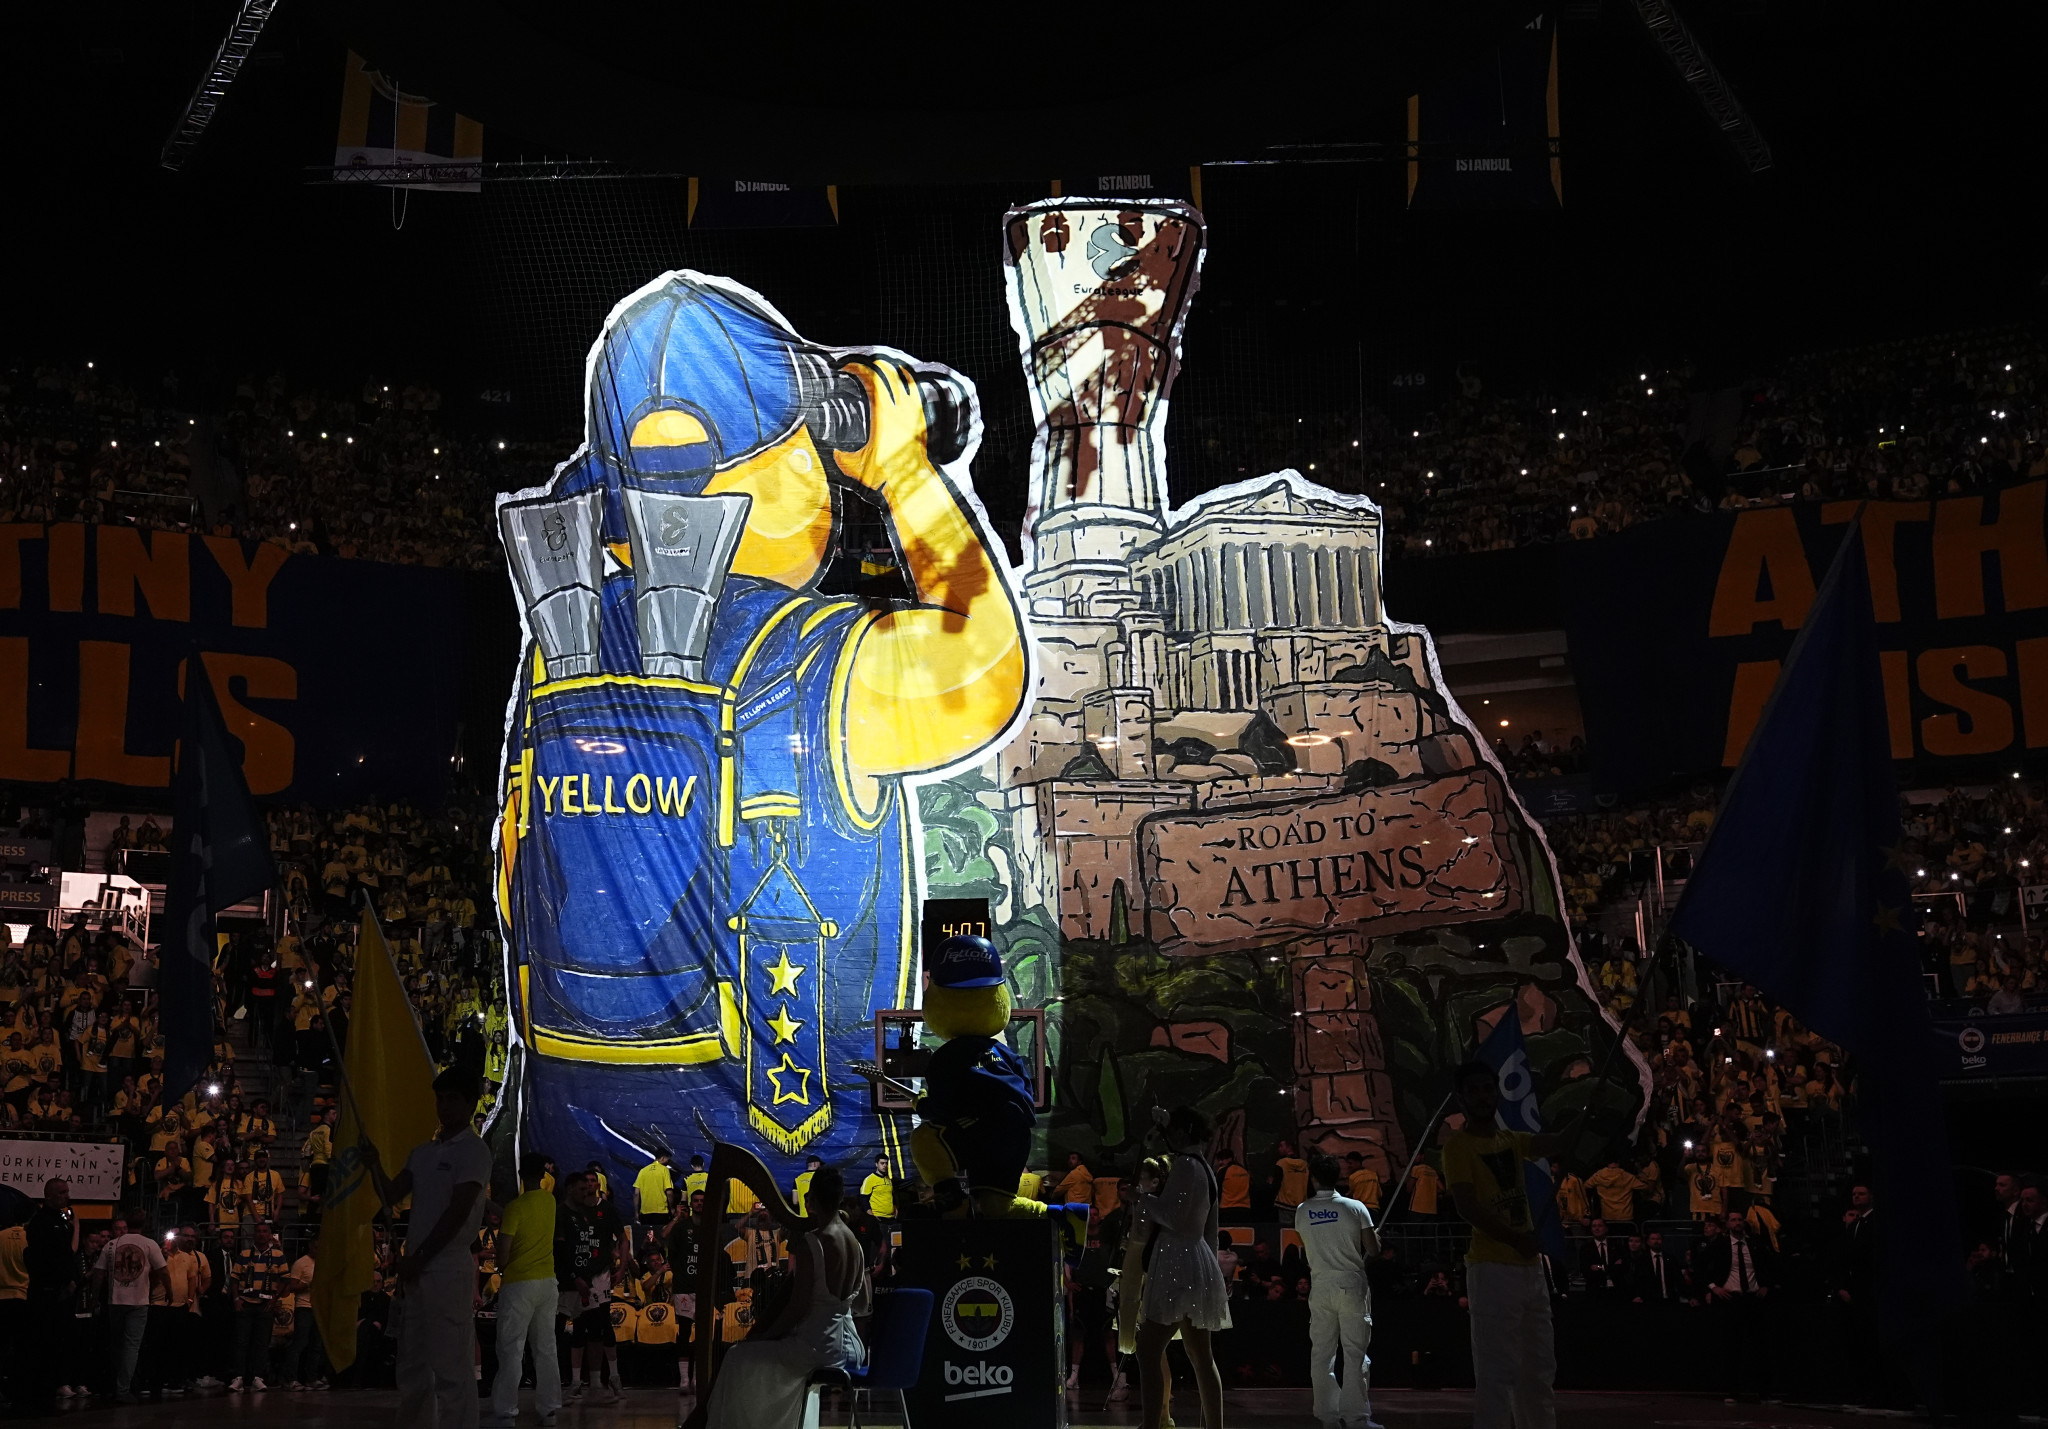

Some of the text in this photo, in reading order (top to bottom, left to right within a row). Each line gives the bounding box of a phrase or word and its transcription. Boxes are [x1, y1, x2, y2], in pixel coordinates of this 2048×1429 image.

[1098, 174, 1154, 191] ISTANBUL
[1392, 372, 1426, 387] 419
[480, 389, 511, 403] 421
[739, 685, 792, 721] YELLOW LEGACY
[537, 772, 698, 818] YELLOW
[1237, 812, 1375, 850] ROAD TO
[1219, 845, 1428, 908] ATHENS
[1, 890, 41, 903] PRESS
[1961, 1055, 1987, 1065] beko
[1308, 1209, 1339, 1220] beko
[944, 1279, 974, 1335] FENERBAHÇE
[977, 1279, 1002, 1296] SPOR
[967, 1339, 988, 1349] 1907
[944, 1360, 1014, 1386] beko
